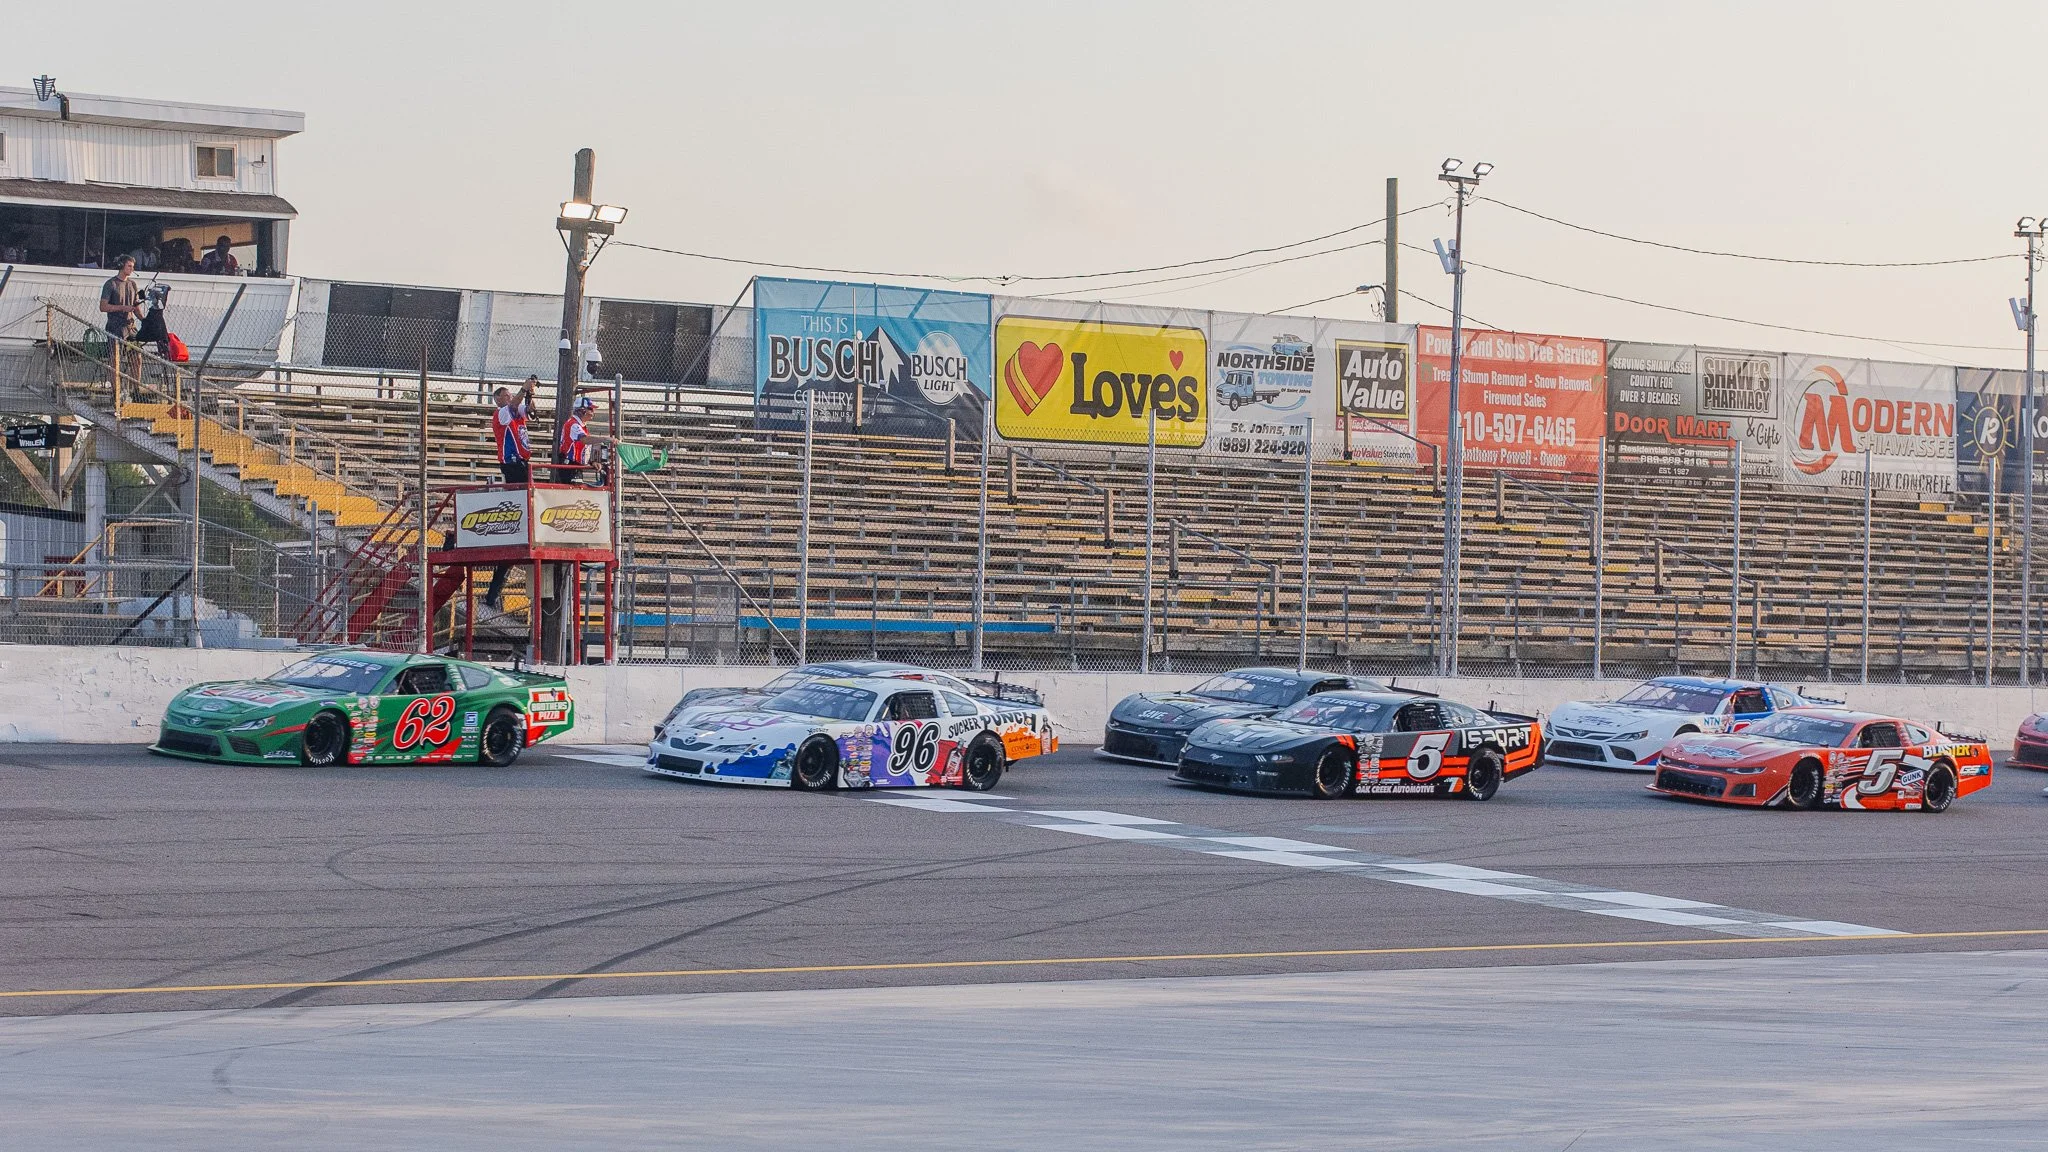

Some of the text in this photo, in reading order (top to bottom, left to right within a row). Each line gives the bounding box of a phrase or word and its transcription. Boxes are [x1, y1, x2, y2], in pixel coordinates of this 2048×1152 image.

[801, 315, 848, 334] THIS IS
[1425, 333, 1598, 365] Powll and Sons Tree Service
[768, 334, 881, 389] BUSCH
[911, 354, 967, 381] BUSCH
[1217, 352, 1315, 372] NORTHSIDE
[1343, 350, 1402, 381] Auto
[1613, 357, 1692, 375] SERVING SHIAWASSEE
[1257, 371, 1314, 388] TOWING
[1462, 368, 1489, 386] Stump
[1491, 370, 1527, 387] Removal
[1534, 374, 1557, 388] Snow
[1558, 376, 1593, 392] Removal
[1630, 374, 1673, 389] COUNTY FOR
[1703, 357, 1770, 391] SHAW'S
[924, 379, 955, 392] LIGHT
[1341, 379, 1406, 411] Value
[1483, 390, 1547, 408] Firewood Sales
[1620, 389, 1681, 406] OVER 3 DECADES!
[1704, 388, 1770, 412] PHARMACY
[1231, 422, 1246, 434] St.
[1250, 423, 1285, 437] Johns,
[1614, 411, 1731, 440] DOOR MART
[1746, 415, 1782, 449] & Gifts
[1799, 393, 1955, 454] MODERN
[1218, 437, 1307, 456] (989) 224-920
[1500, 447, 1532, 465] Powell
[1540, 450, 1567, 467] Owner
[1620, 444, 1670, 456] Residential
[1678, 447, 1729, 459] Commercial
[1856, 433, 1955, 459] SHIAWASSEE
[1895, 472, 1951, 494] CONCRETE
[392, 695, 456, 750] 62
[538, 711, 561, 720] PIZZA
[948, 718, 982, 739] SUCKER
[981, 711, 1037, 734] PUNCH
[1703, 717, 1721, 726] NTN
[887, 721, 941, 776] 96
[1406, 732, 1452, 782] 5
[1922, 744, 1972, 759] BLASTER
[1856, 749, 1904, 796] 5
[1902, 771, 1922, 783] GUNK
[1356, 785, 1435, 794] OAK CREEK AUTOMOTIVE
